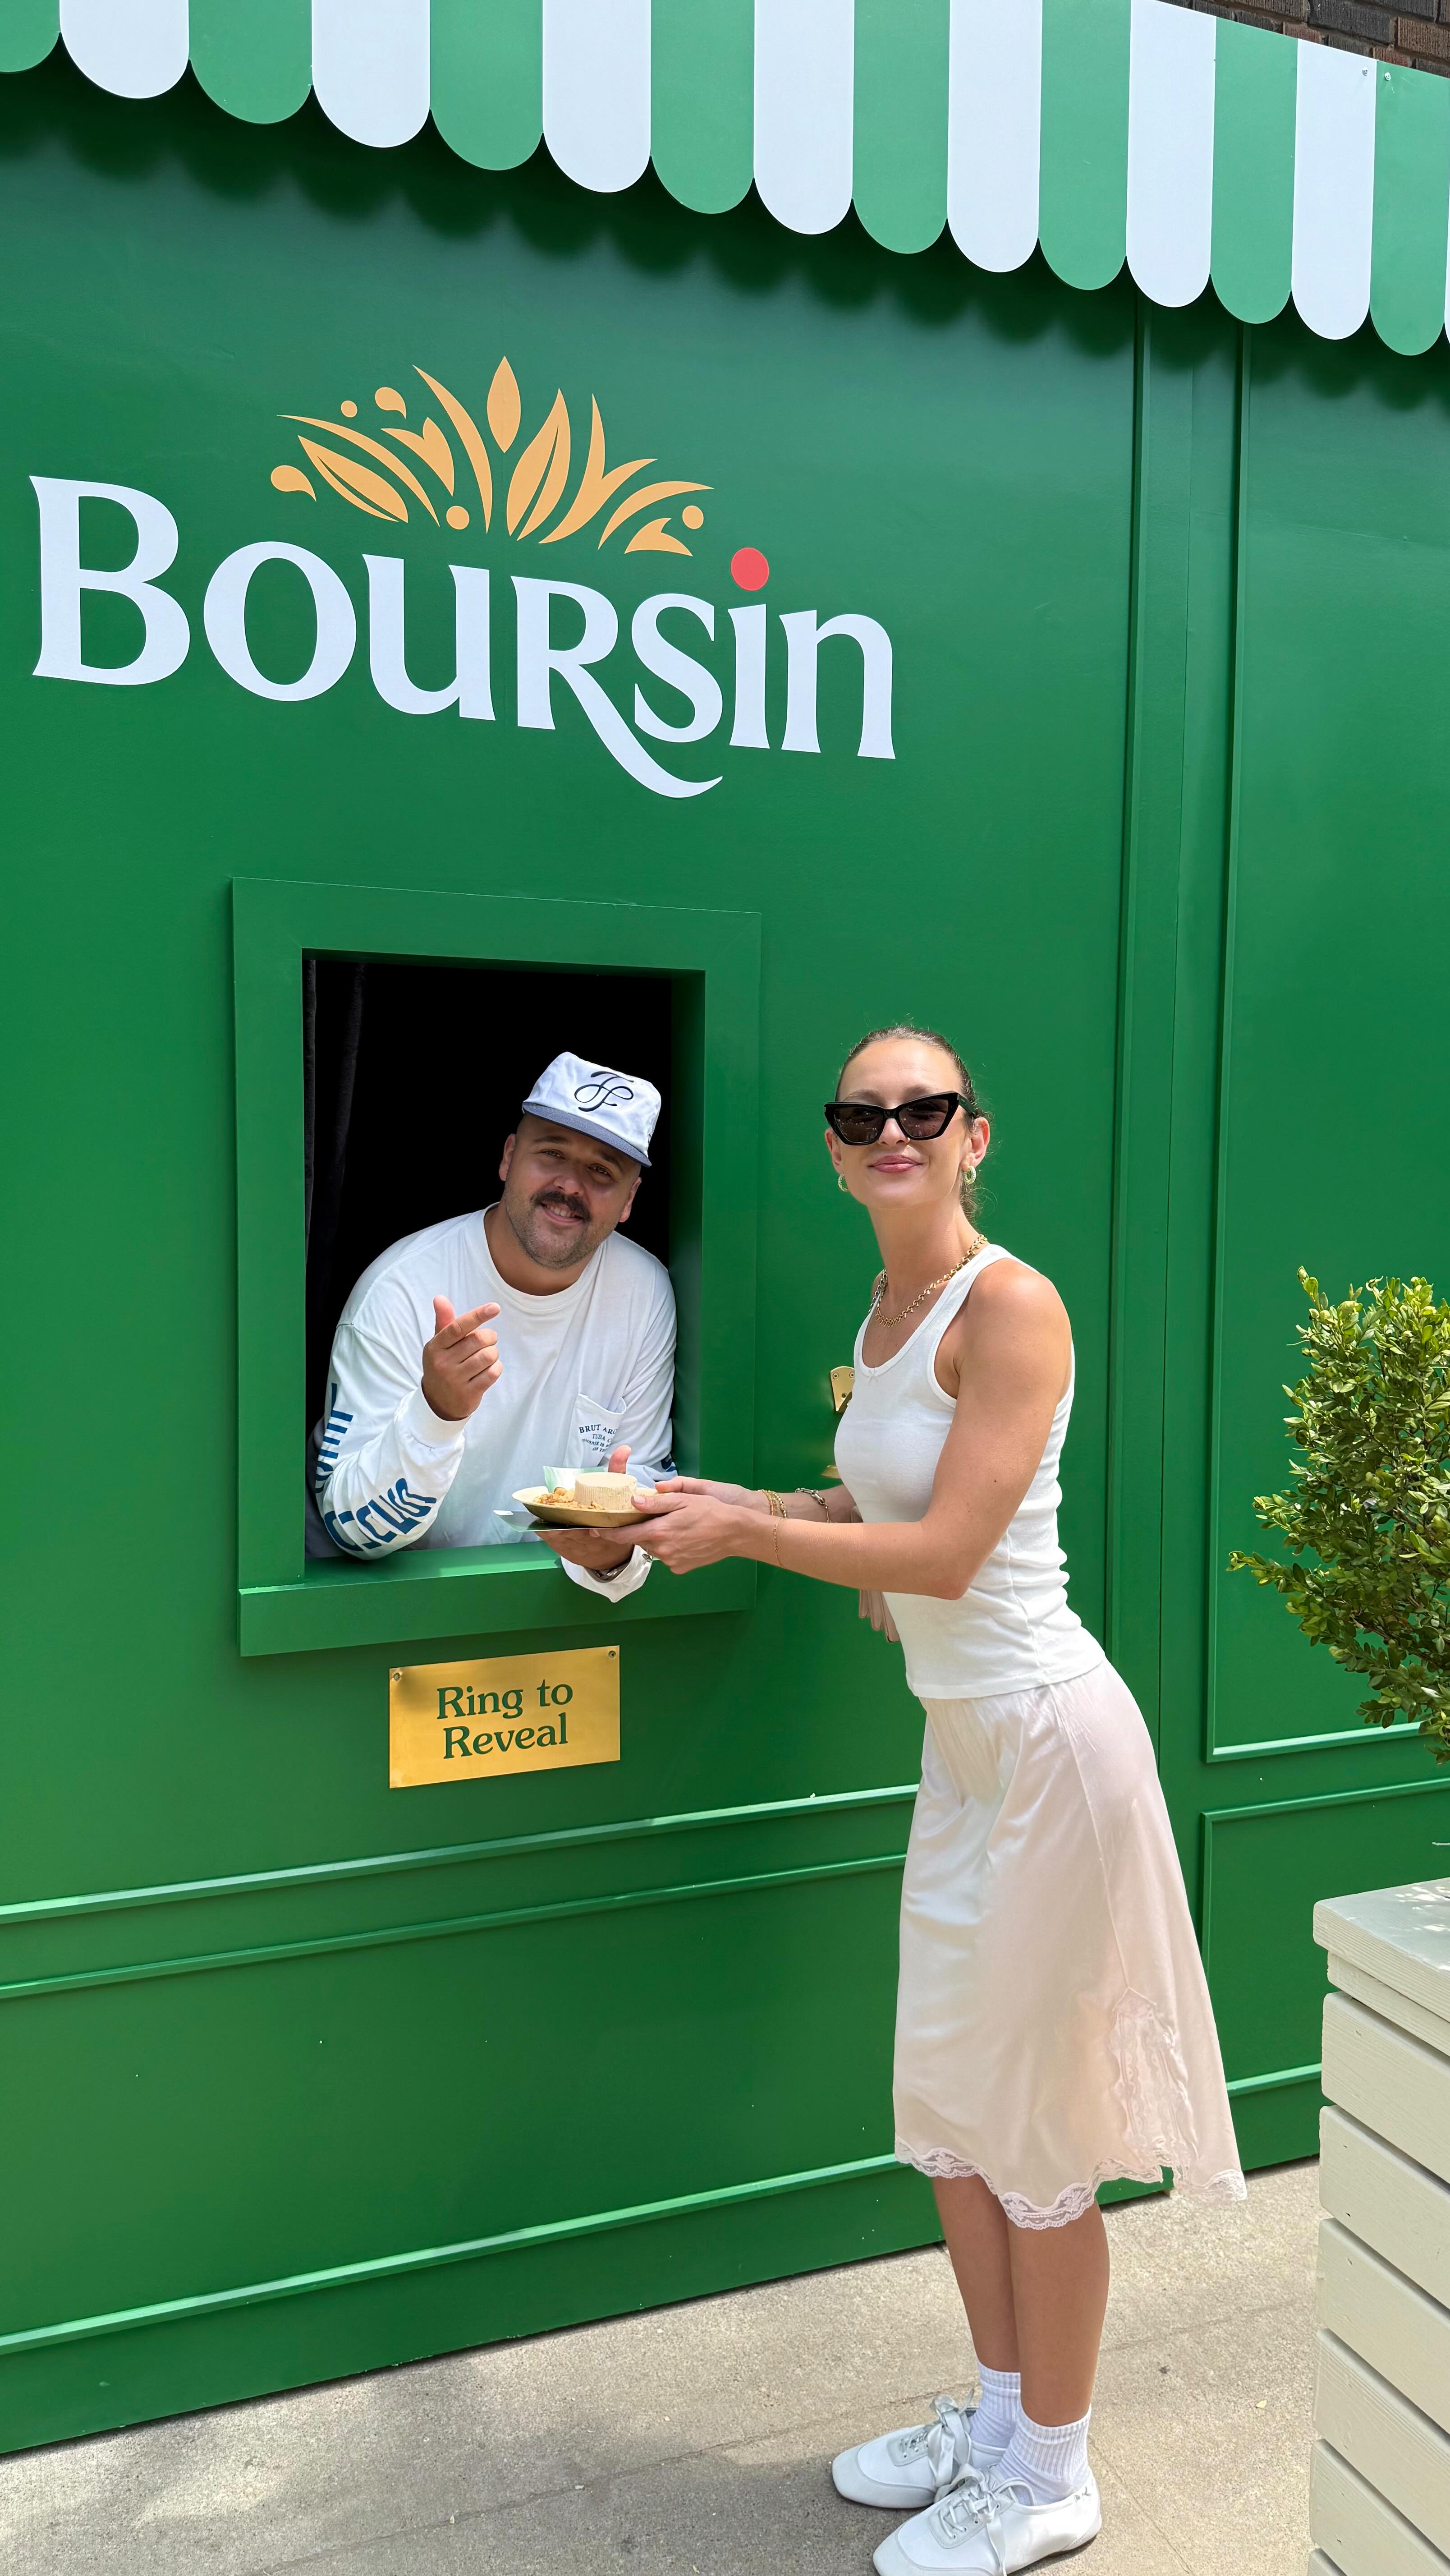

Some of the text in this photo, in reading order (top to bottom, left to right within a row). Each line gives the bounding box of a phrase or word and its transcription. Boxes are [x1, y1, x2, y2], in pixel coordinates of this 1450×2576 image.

[578, 1424, 601, 1433] BRUT
[436, 1679, 573, 1720] Ring to
[443, 1712, 568, 1759] Reveal
